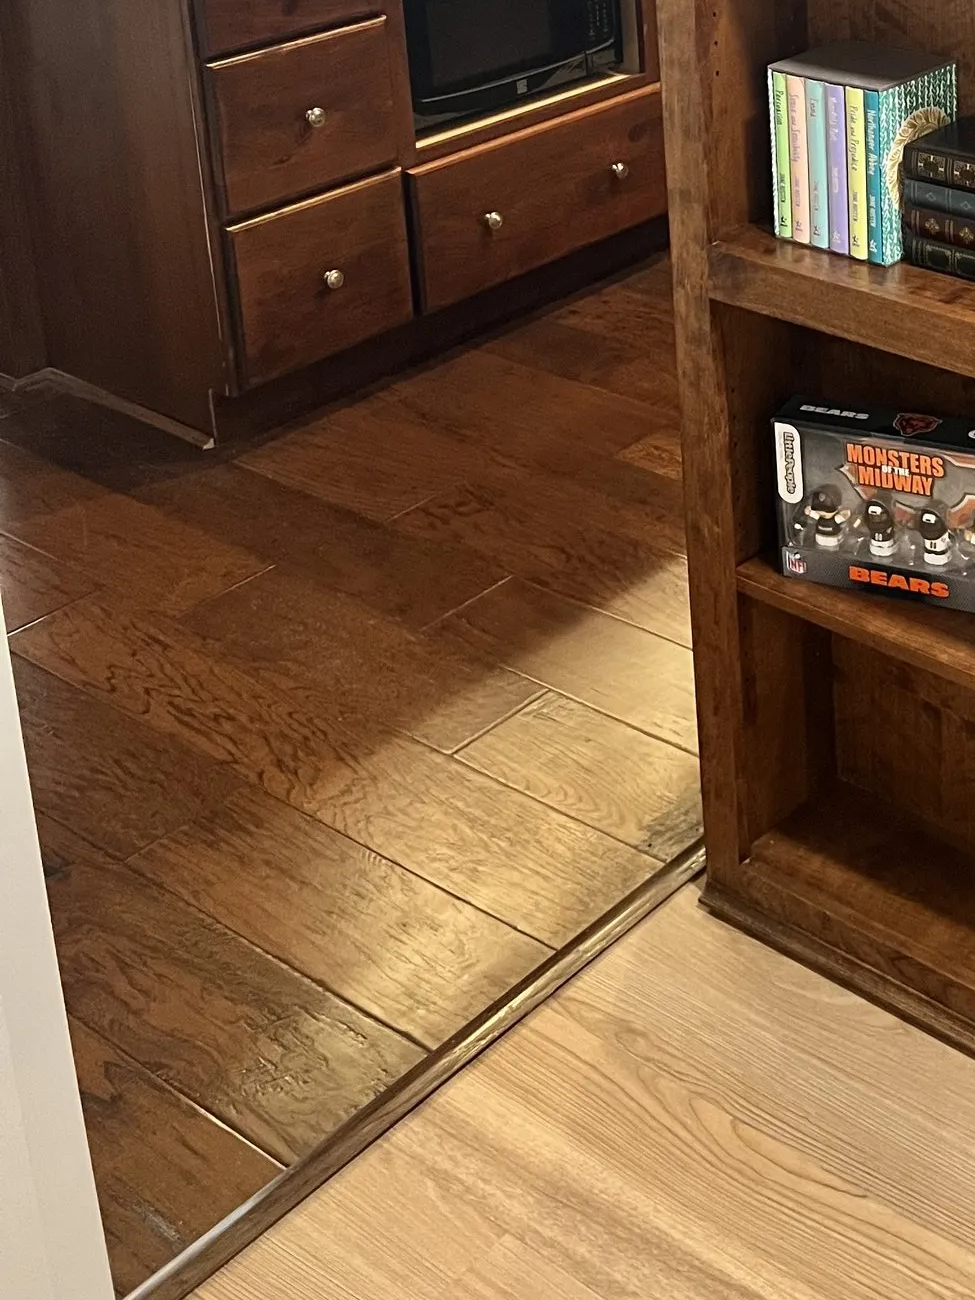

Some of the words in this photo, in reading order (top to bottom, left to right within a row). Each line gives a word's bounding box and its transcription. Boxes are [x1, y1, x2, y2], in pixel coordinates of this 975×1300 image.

[799, 404, 870, 420] BEARS
[846, 443, 945, 478] MONSTERS
[881, 464, 893, 474] OF
[893, 466, 910, 477] THE
[858, 465, 933, 496] MIDWAY
[848, 565, 950, 598] BEARS
